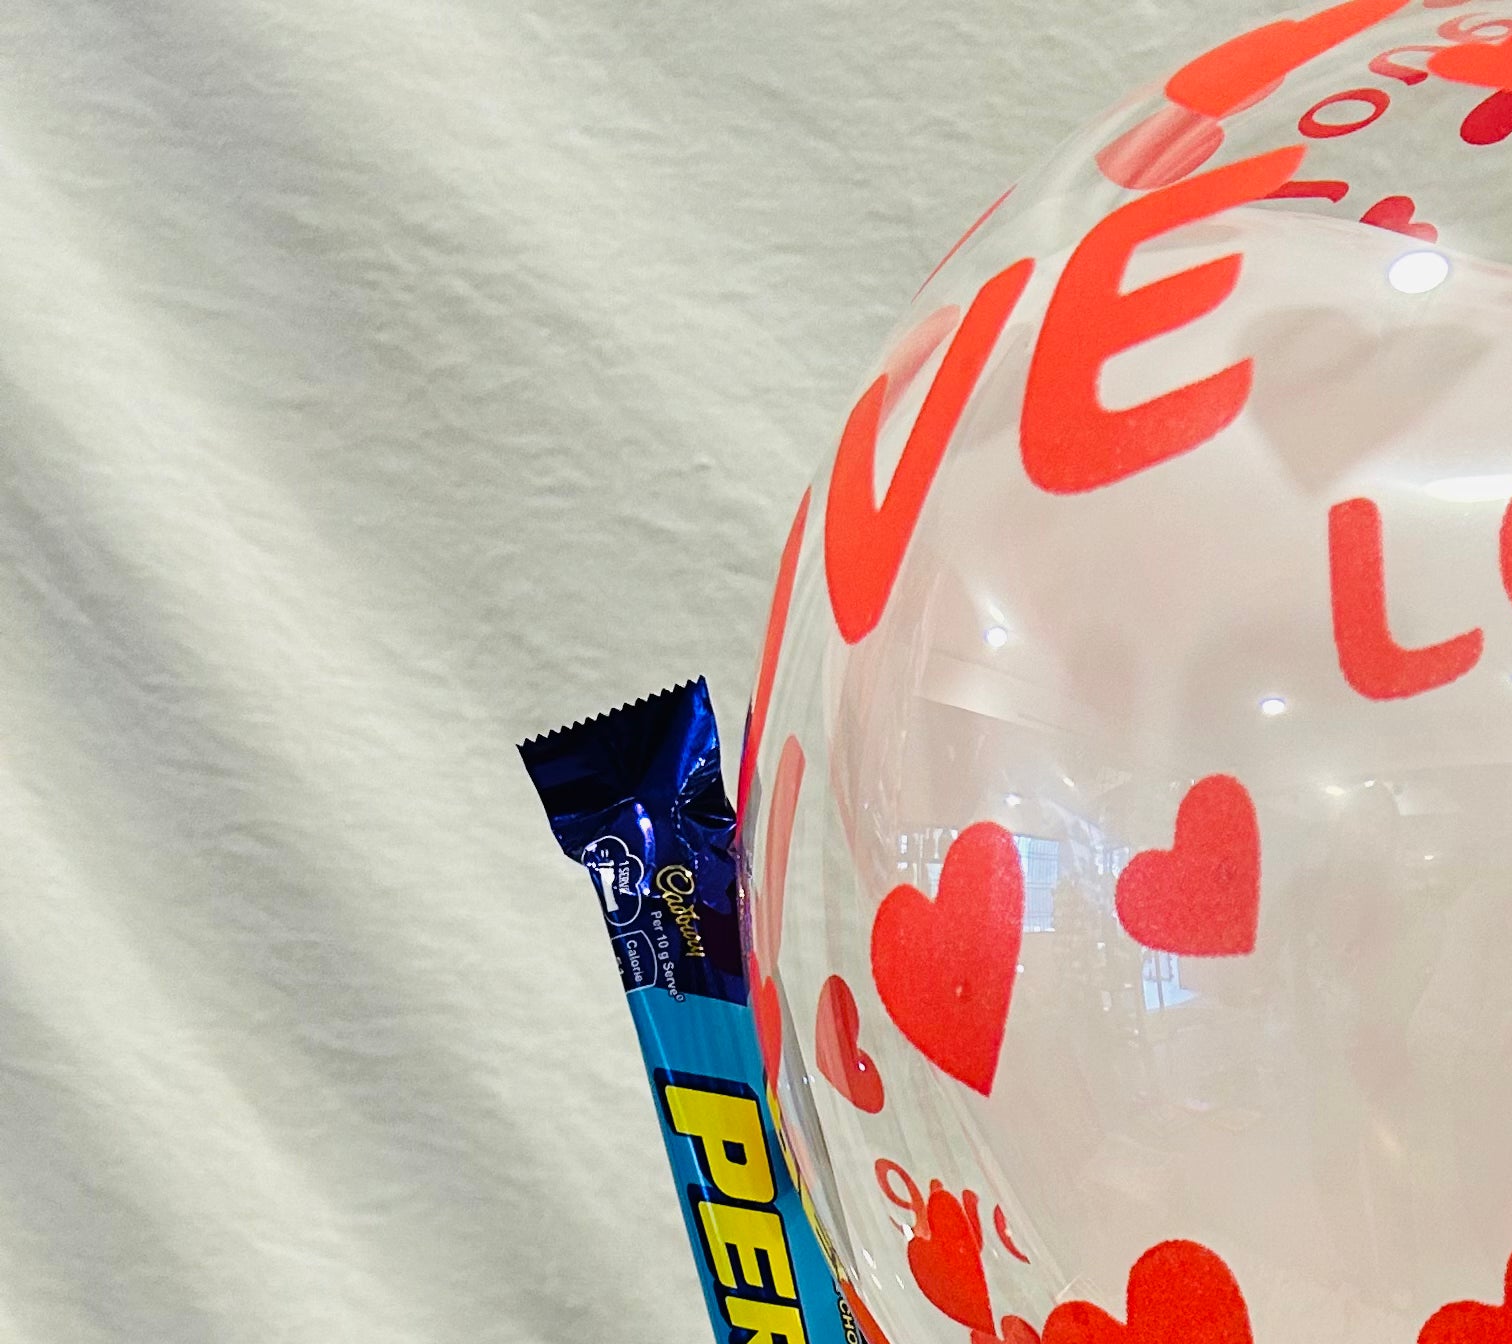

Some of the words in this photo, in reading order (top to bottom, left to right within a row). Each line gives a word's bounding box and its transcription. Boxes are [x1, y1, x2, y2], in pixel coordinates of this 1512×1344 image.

[792, 144, 1308, 646] VE
[651, 910, 663, 932] Per
[656, 864, 706, 957] Cadbury
[626, 939, 643, 983] Calorie
[656, 934, 670, 949] 10
